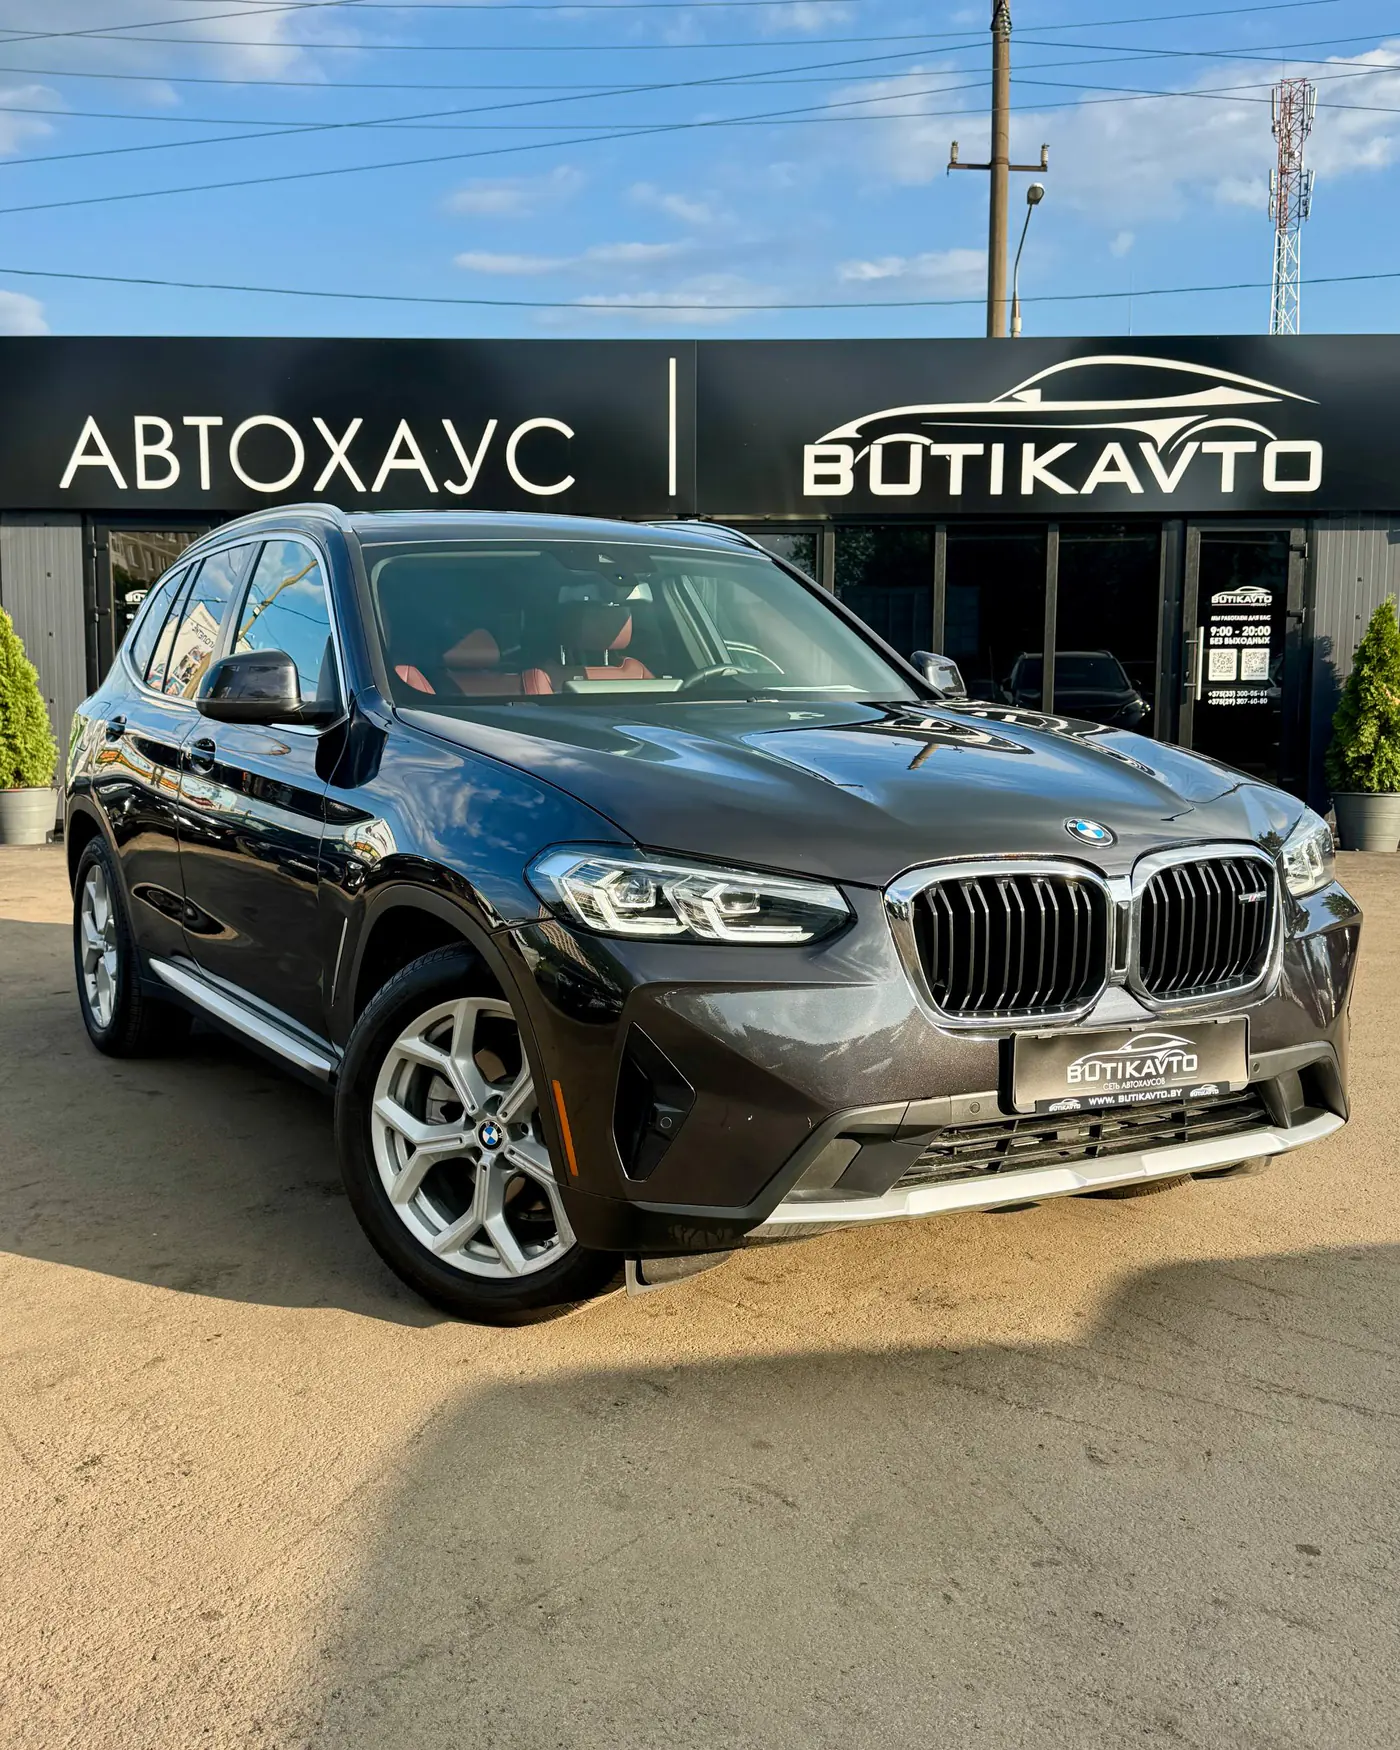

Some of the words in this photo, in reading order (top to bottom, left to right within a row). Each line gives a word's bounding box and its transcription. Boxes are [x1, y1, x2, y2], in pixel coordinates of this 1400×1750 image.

[58, 414, 576, 496] АВТОХАУС
[803, 439, 1323, 496] BUTIKAVTO
[1211, 595, 1273, 604] BUTIKAVTO
[1210, 626, 1233, 636] 9:00
[1241, 625, 1271, 636] 20:00
[1209, 637, 1223, 645] БЕЗ
[1224, 636, 1271, 645] ВЫХОДНЫХ
[1066, 1054, 1198, 1084] BUTIKAVTO
[1103, 1082, 1120, 1091] СЕТЬ
[1121, 1077, 1165, 1089] АВТОХАУСОВ
[1089, 1096, 1115, 1105] WWW.
[1118, 1089, 1182, 1103] BUTIKAVTO.BY
